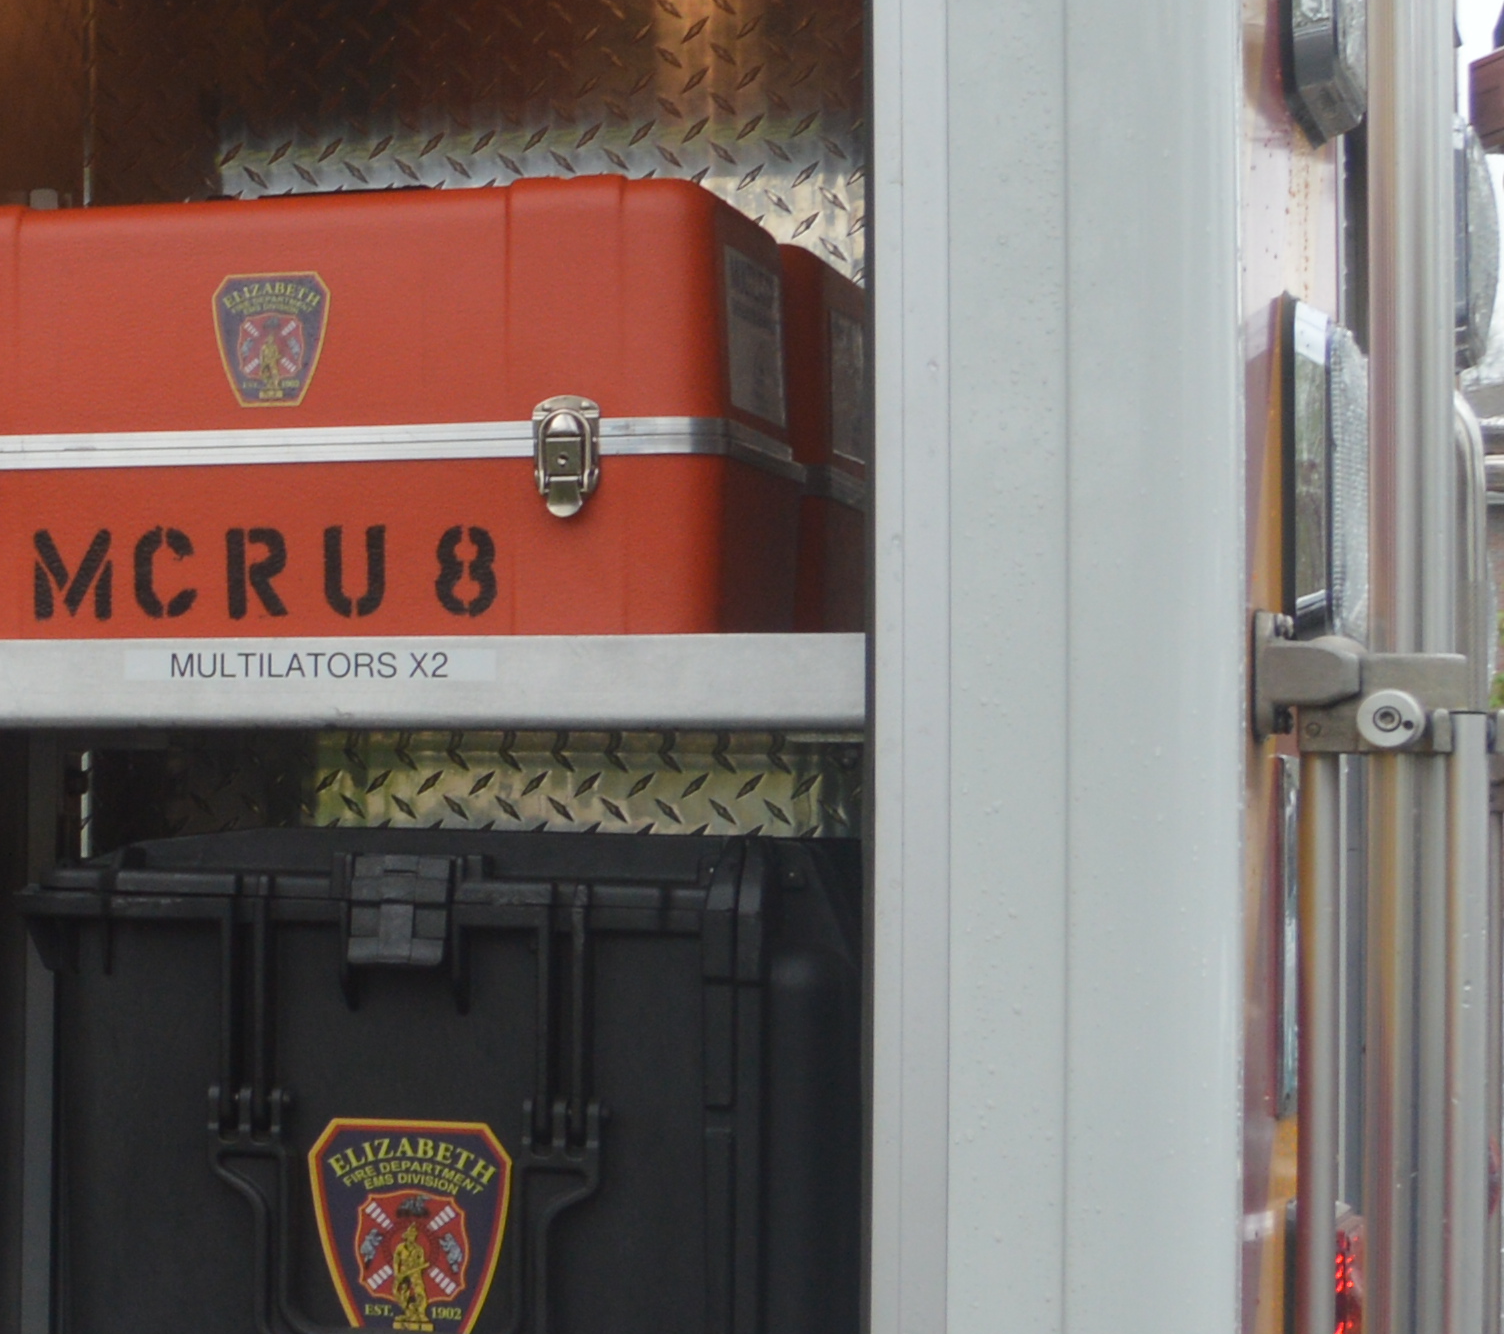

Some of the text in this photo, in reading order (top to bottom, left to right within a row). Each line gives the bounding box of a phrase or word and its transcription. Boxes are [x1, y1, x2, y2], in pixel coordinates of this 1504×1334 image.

[223, 282, 320, 308] ELIZABETH
[33, 525, 498, 621] MCRU 8
[170, 652, 449, 679] MULTILATORS X2
[327, 1137, 498, 1186] ELIZABETH
[342, 1160, 484, 1195] FIRE DEPARTMENT
[364, 1172, 460, 1195] EMS DIVISION
[364, 1304, 462, 1320] EST. 1902
